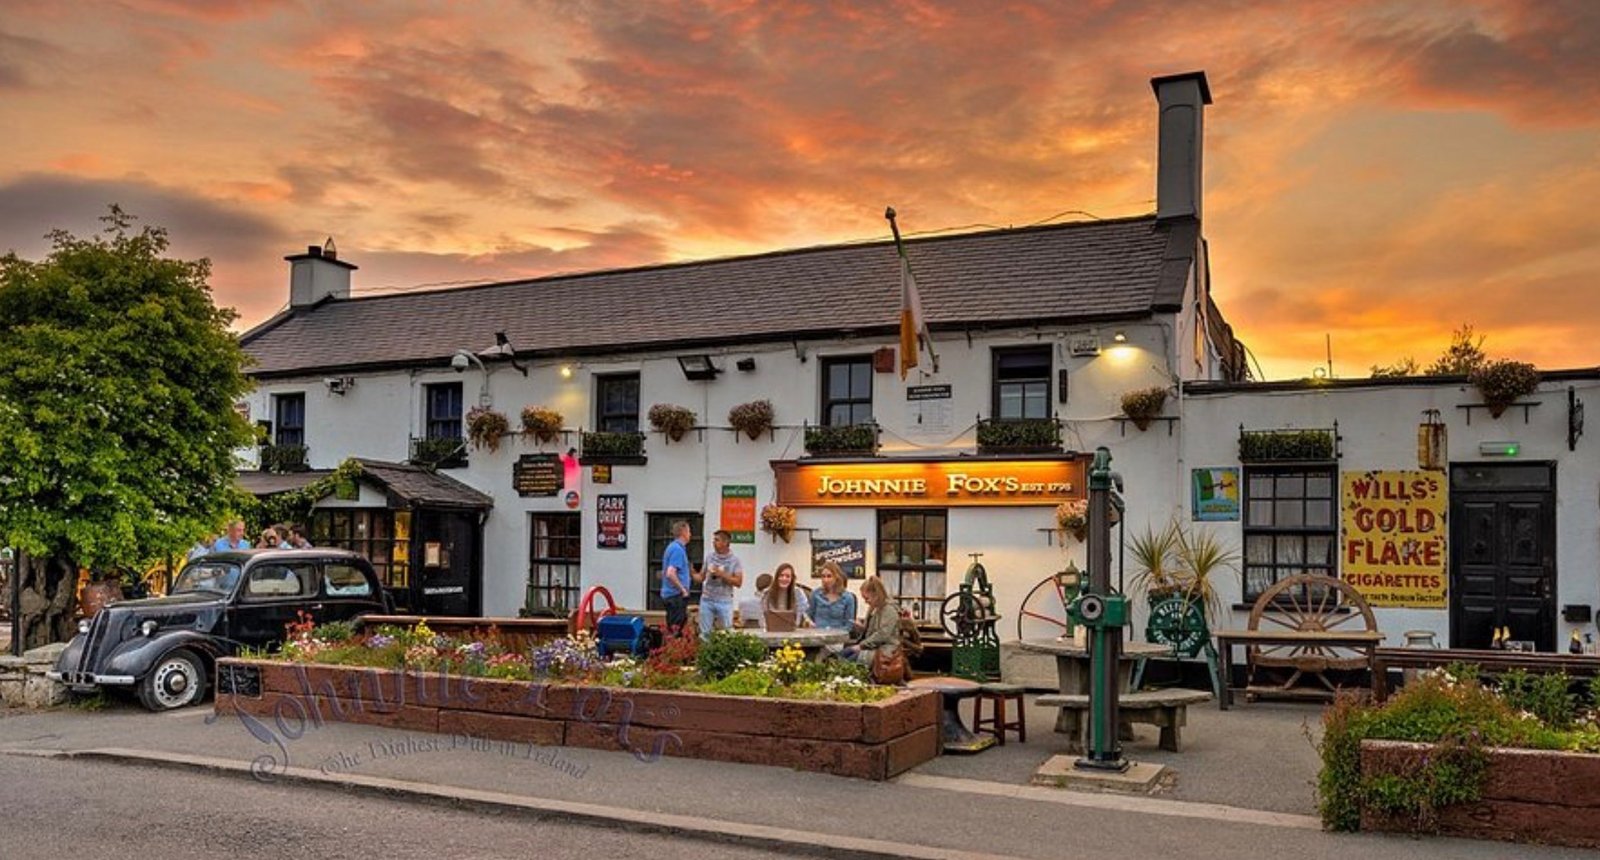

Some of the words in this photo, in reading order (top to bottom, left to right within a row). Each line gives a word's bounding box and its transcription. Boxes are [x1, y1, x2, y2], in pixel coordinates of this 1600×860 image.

[817, 475, 926, 494] JOHNNIE
[947, 473, 1019, 493] FOX'S
[1020, 482, 1045, 492] EST
[600, 497, 625, 510] PARK
[598, 510, 625, 525] DRIVE
[1346, 573, 1440, 588] CIGARETTES
